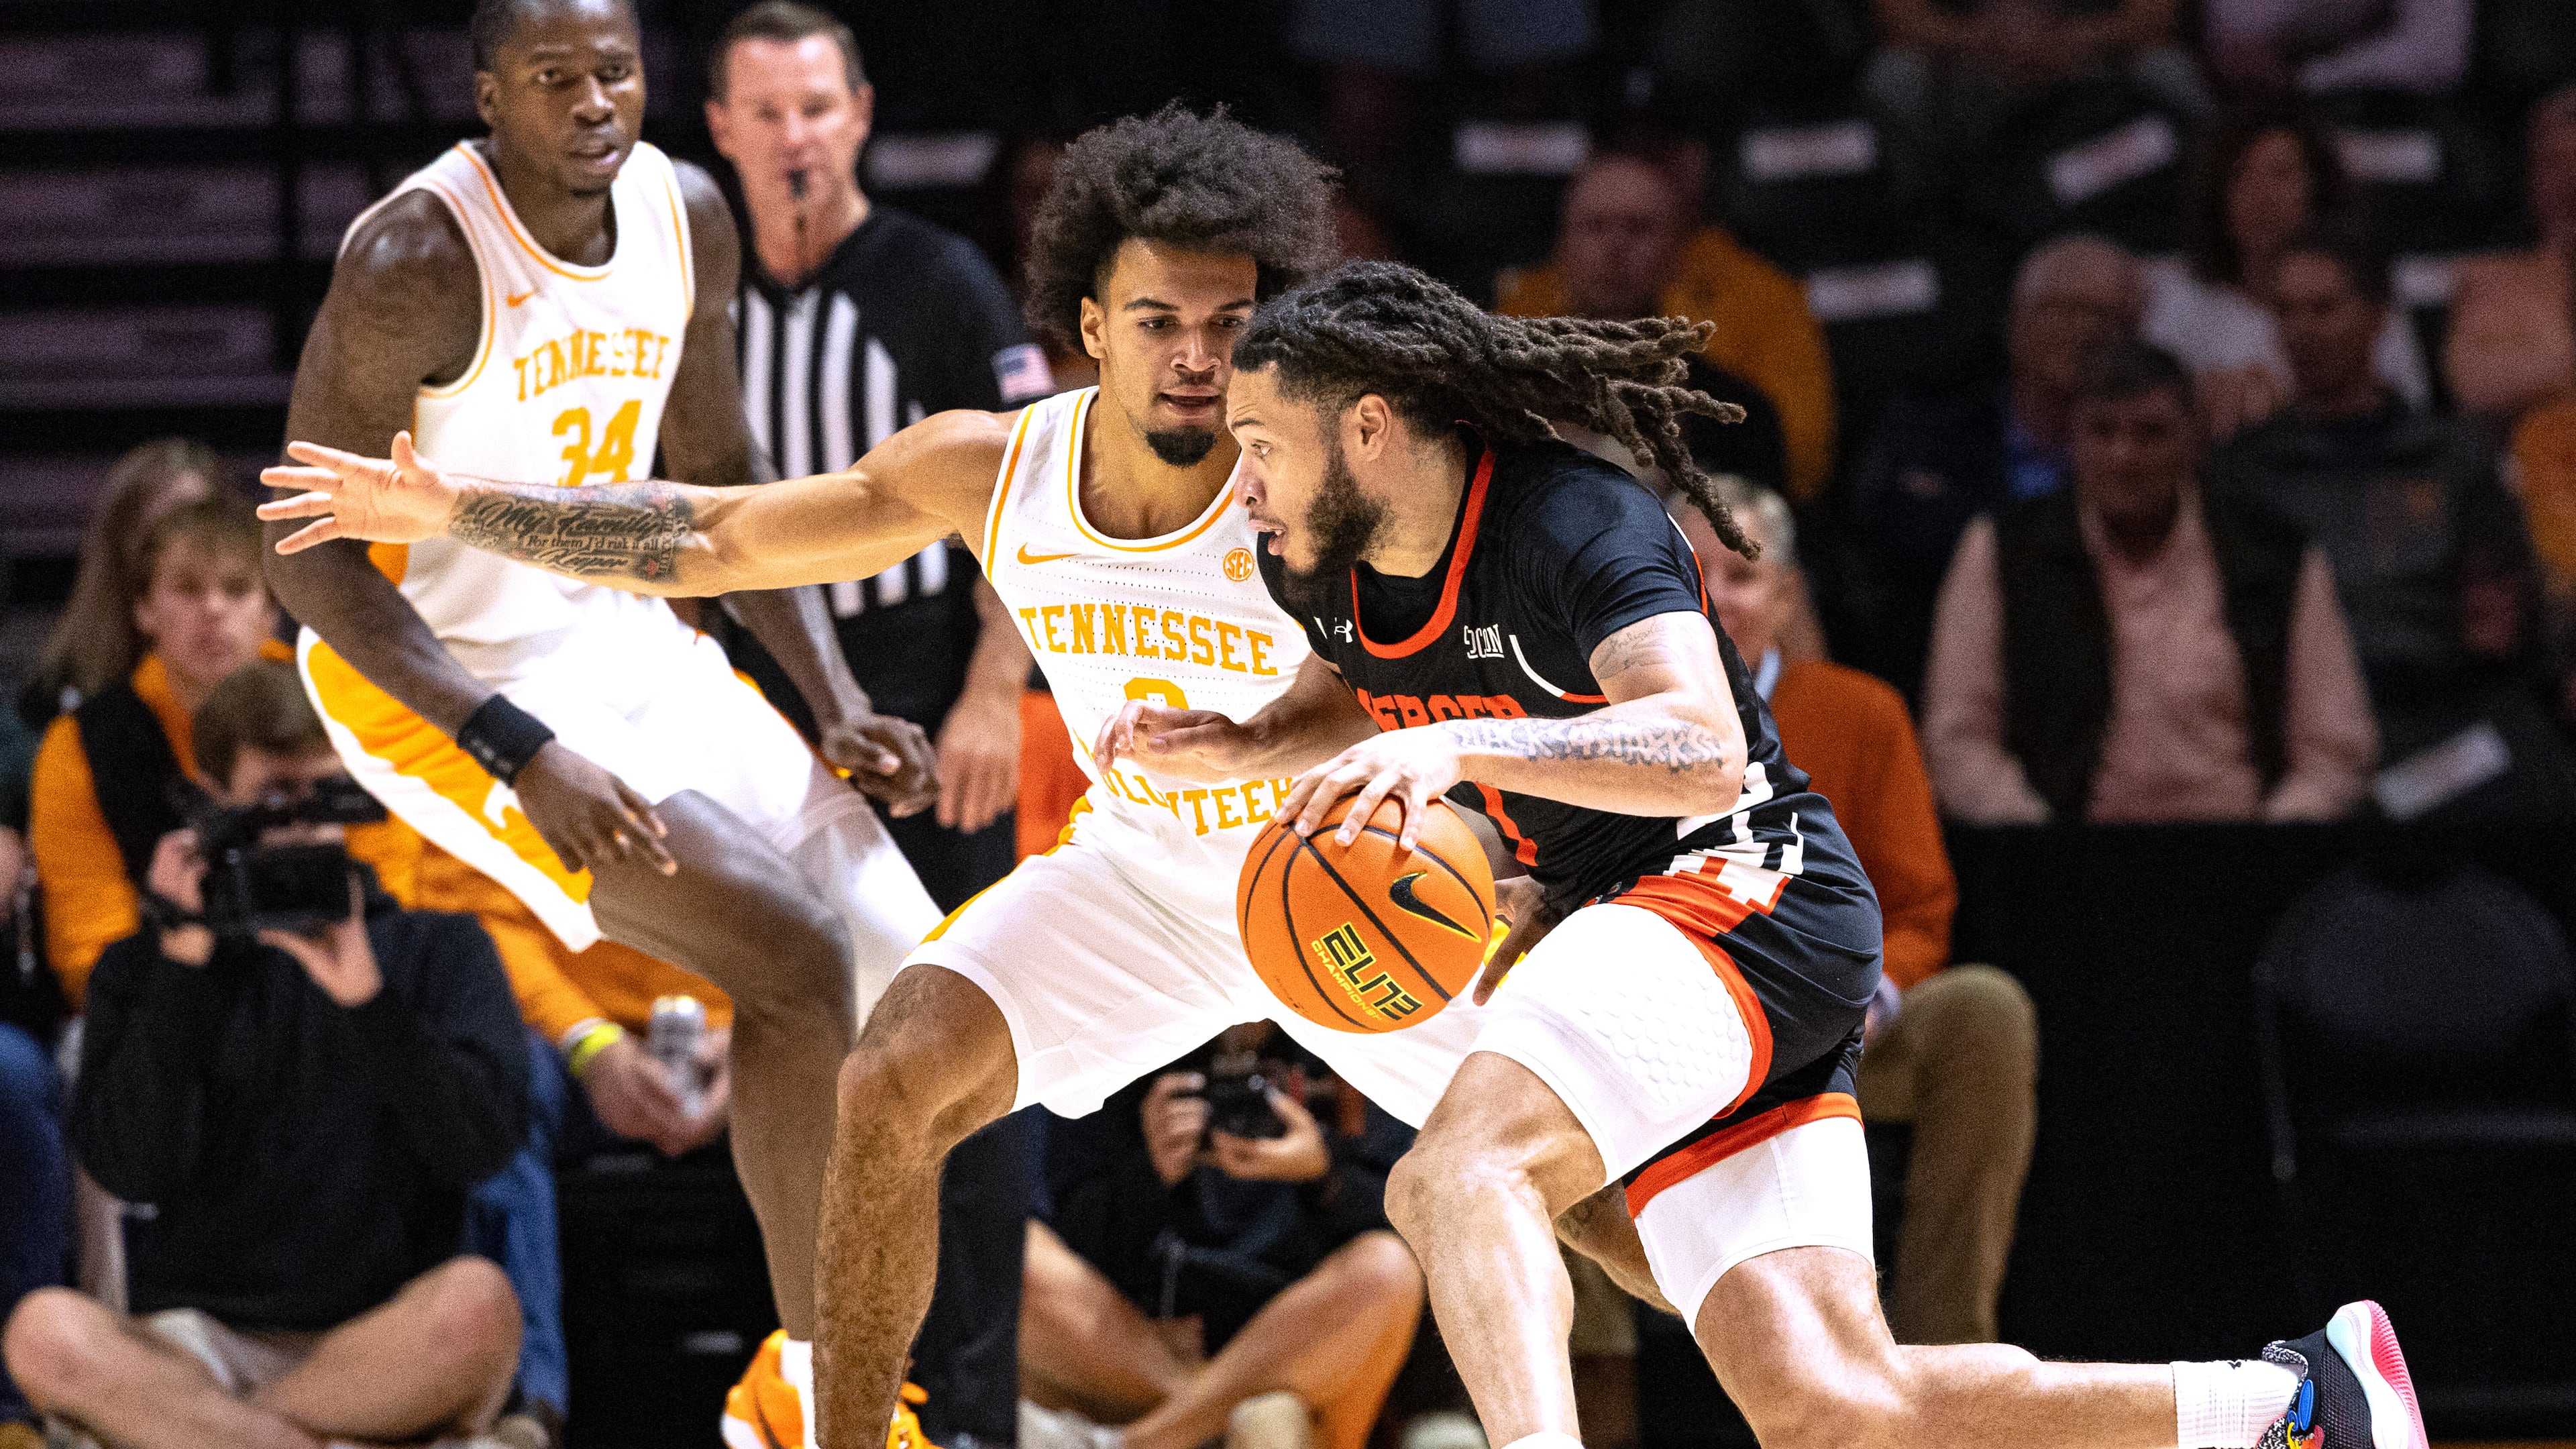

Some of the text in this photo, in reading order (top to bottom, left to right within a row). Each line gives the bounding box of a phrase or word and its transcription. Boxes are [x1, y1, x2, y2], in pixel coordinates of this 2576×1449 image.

[551, 399, 642, 487] 34
[1227, 551, 1252, 578] SEC
[1018, 603, 1278, 676] TENNESSEE
[1320, 921, 1424, 1021] ELITE
